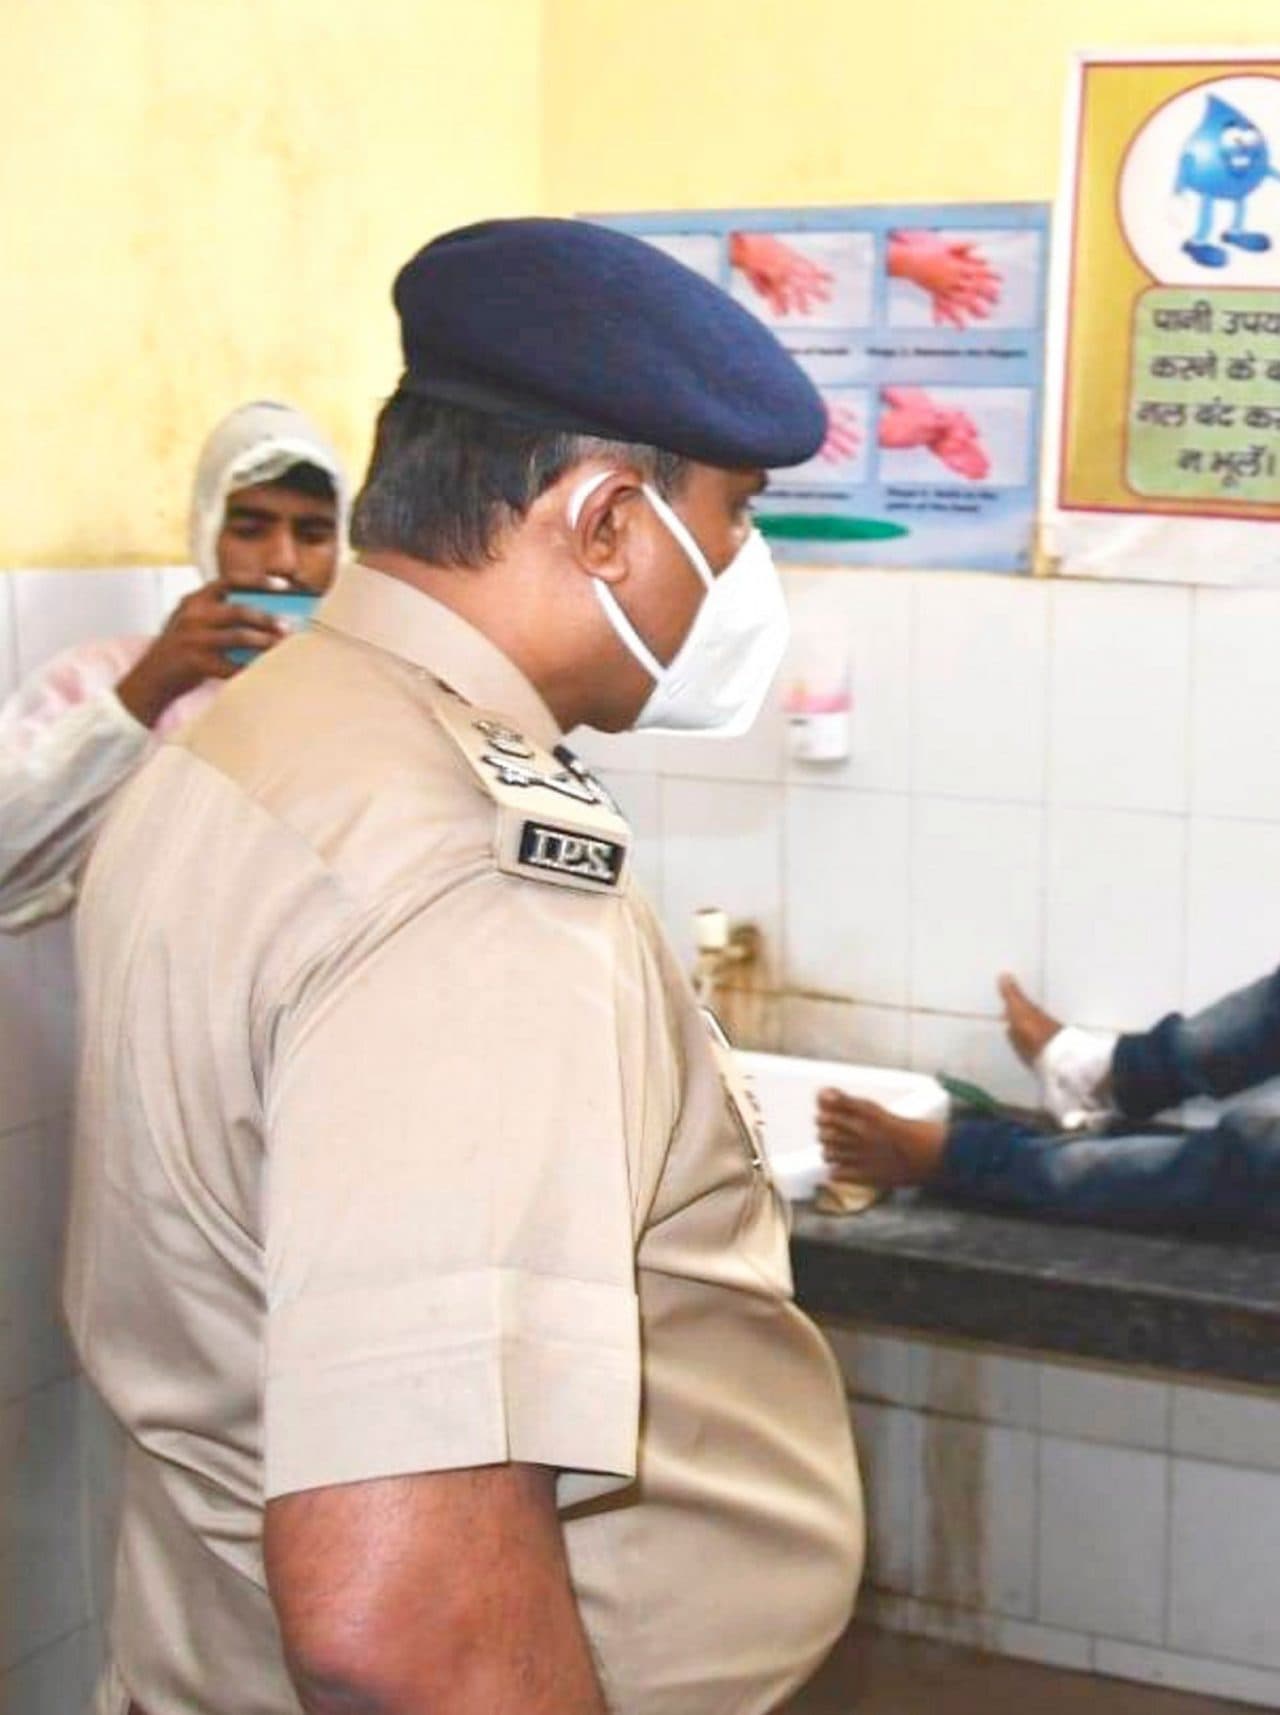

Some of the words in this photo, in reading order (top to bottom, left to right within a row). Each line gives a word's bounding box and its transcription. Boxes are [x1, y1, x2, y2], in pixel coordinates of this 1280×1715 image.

[1153, 300, 1212, 333] पानी
[1151, 349, 1218, 380] करने
[1225, 350, 1256, 380] के
[1137, 402, 1187, 427] नल
[1195, 396, 1235, 427] बंद
[1178, 448, 1203, 473] न
[528, 828, 615, 880] IPS
